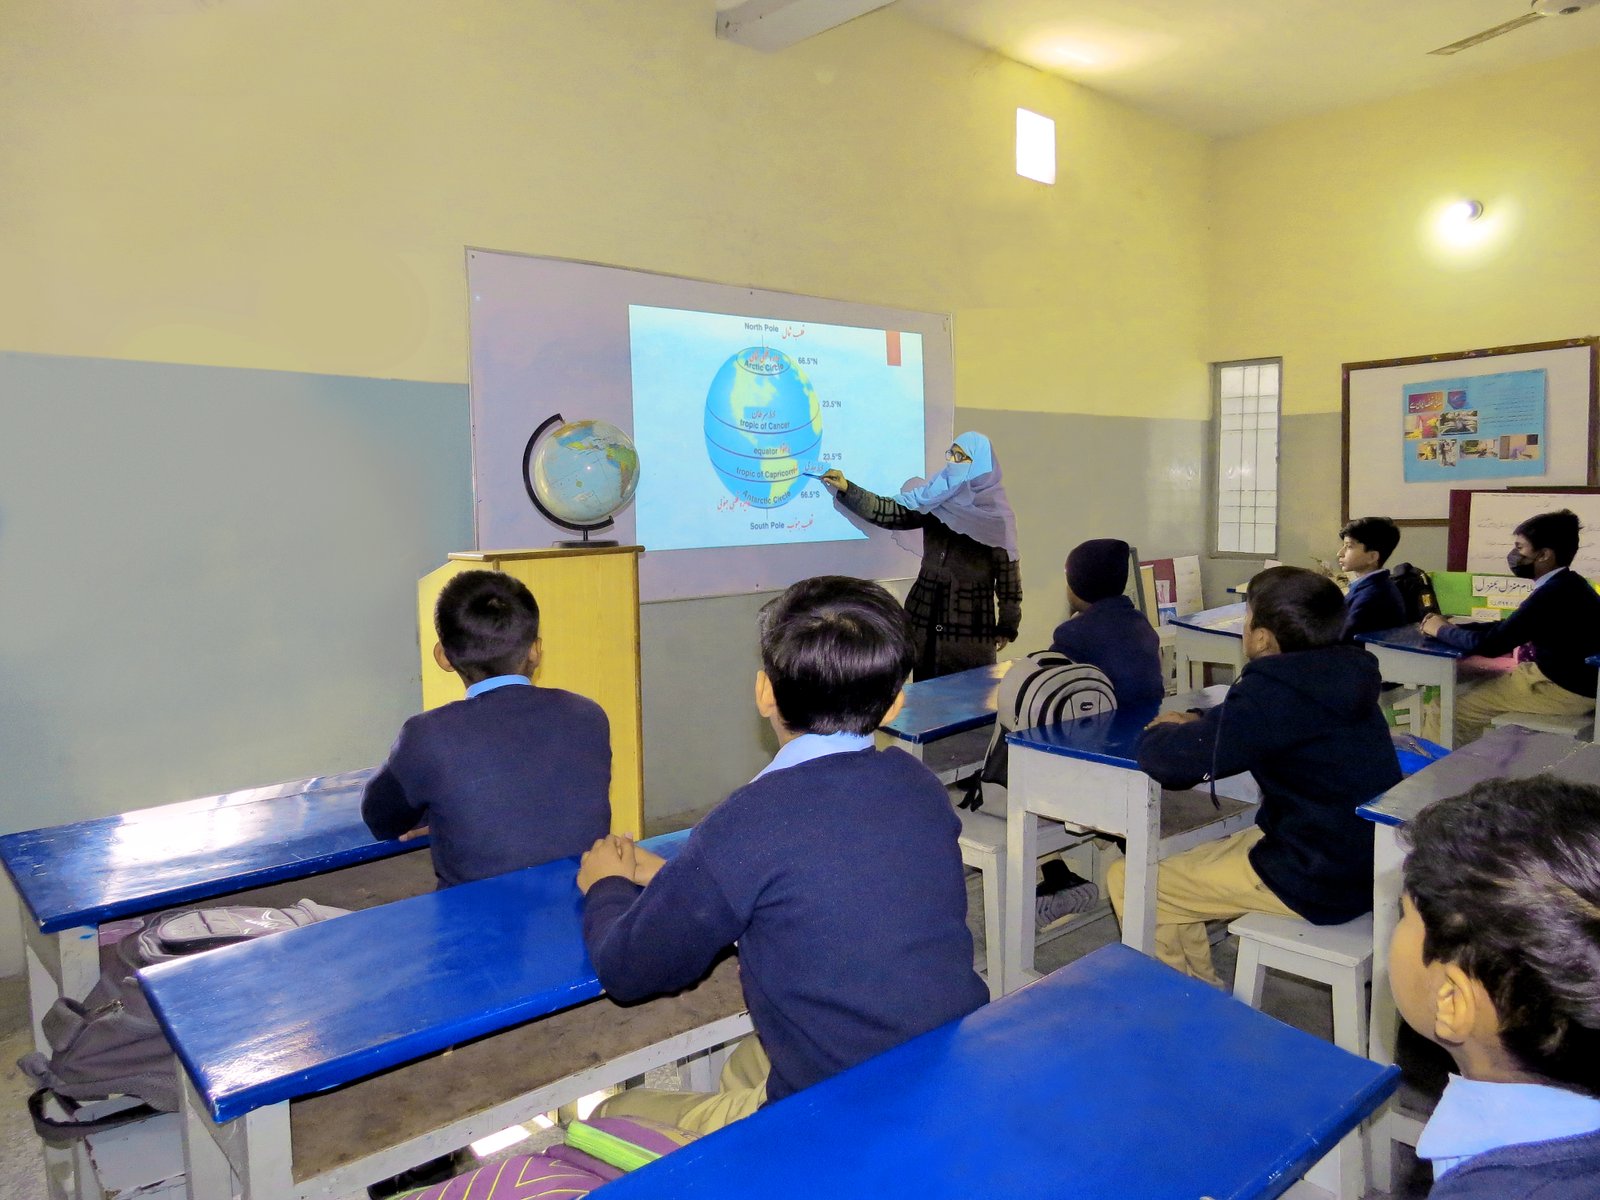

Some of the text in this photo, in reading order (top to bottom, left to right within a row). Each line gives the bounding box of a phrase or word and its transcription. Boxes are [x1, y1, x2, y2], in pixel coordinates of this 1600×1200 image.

[744, 322, 779, 333] North Pole
[798, 357, 818, 365] 66.5°N
[744, 361, 784, 372] Arctic Circle
[822, 400, 842, 408] 23.5°N
[740, 419, 790, 430] tropic of Cancer
[753, 447, 778, 455] equator
[823, 453, 842, 461] 23.5°S
[736, 467, 795, 479] tropic of Capricorn
[742, 490, 791, 504] Antarctic Circle
[801, 491, 820, 499] 66.5°S
[750, 521, 785, 530] South Pole
